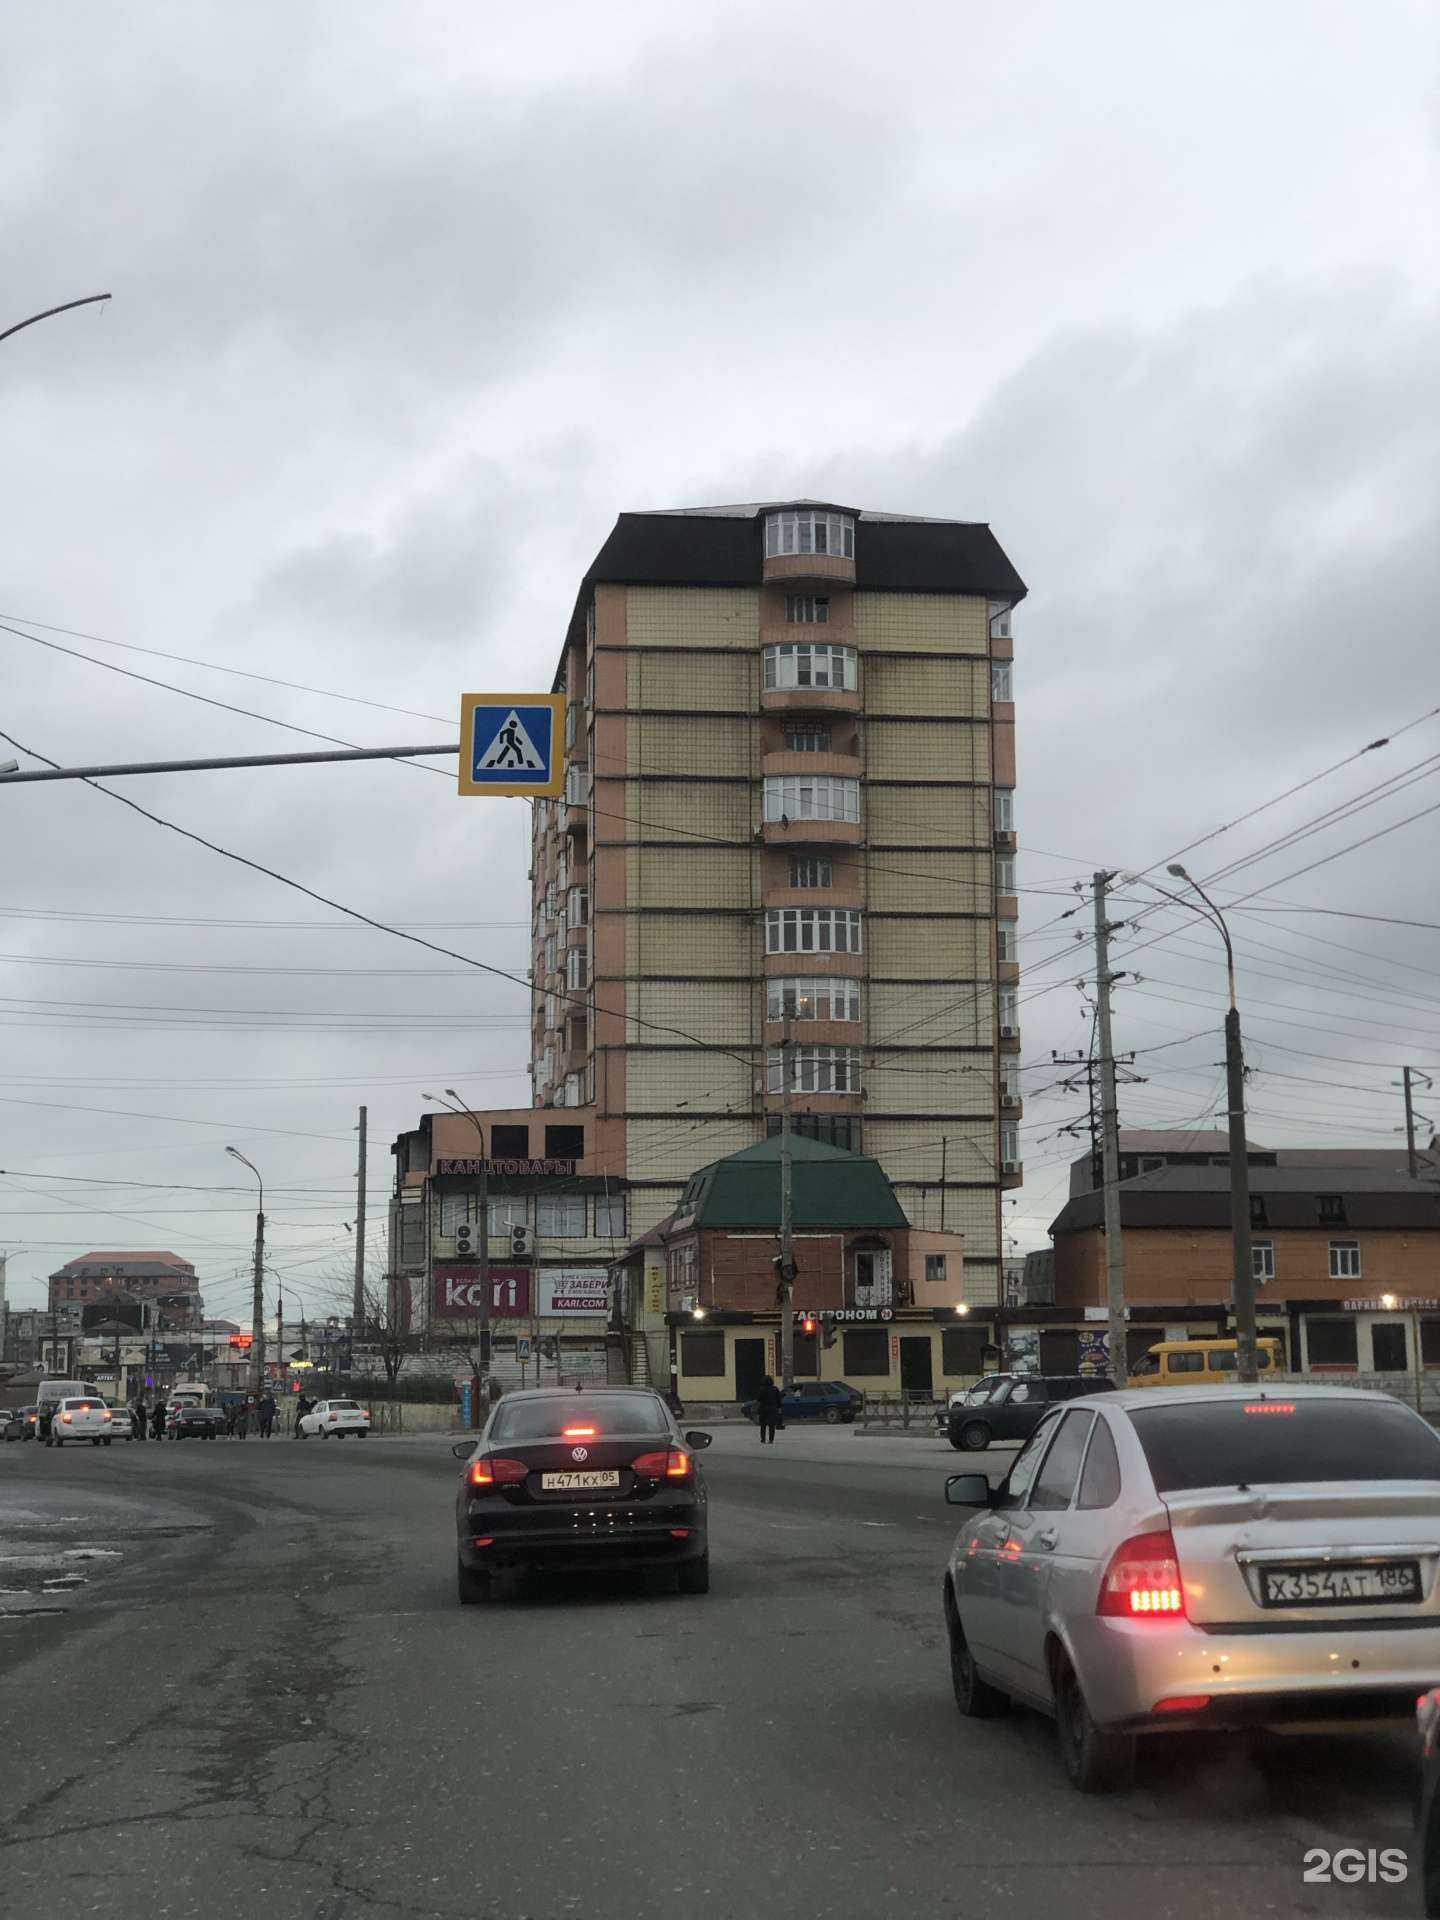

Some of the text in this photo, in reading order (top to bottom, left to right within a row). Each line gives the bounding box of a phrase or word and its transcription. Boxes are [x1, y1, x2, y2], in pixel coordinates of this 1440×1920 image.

[440, 1159, 572, 1175] КАНЦТОВАРЫ
[557, 1299, 605, 1308] KARI.COM
[602, 1471, 615, 1482] 05
